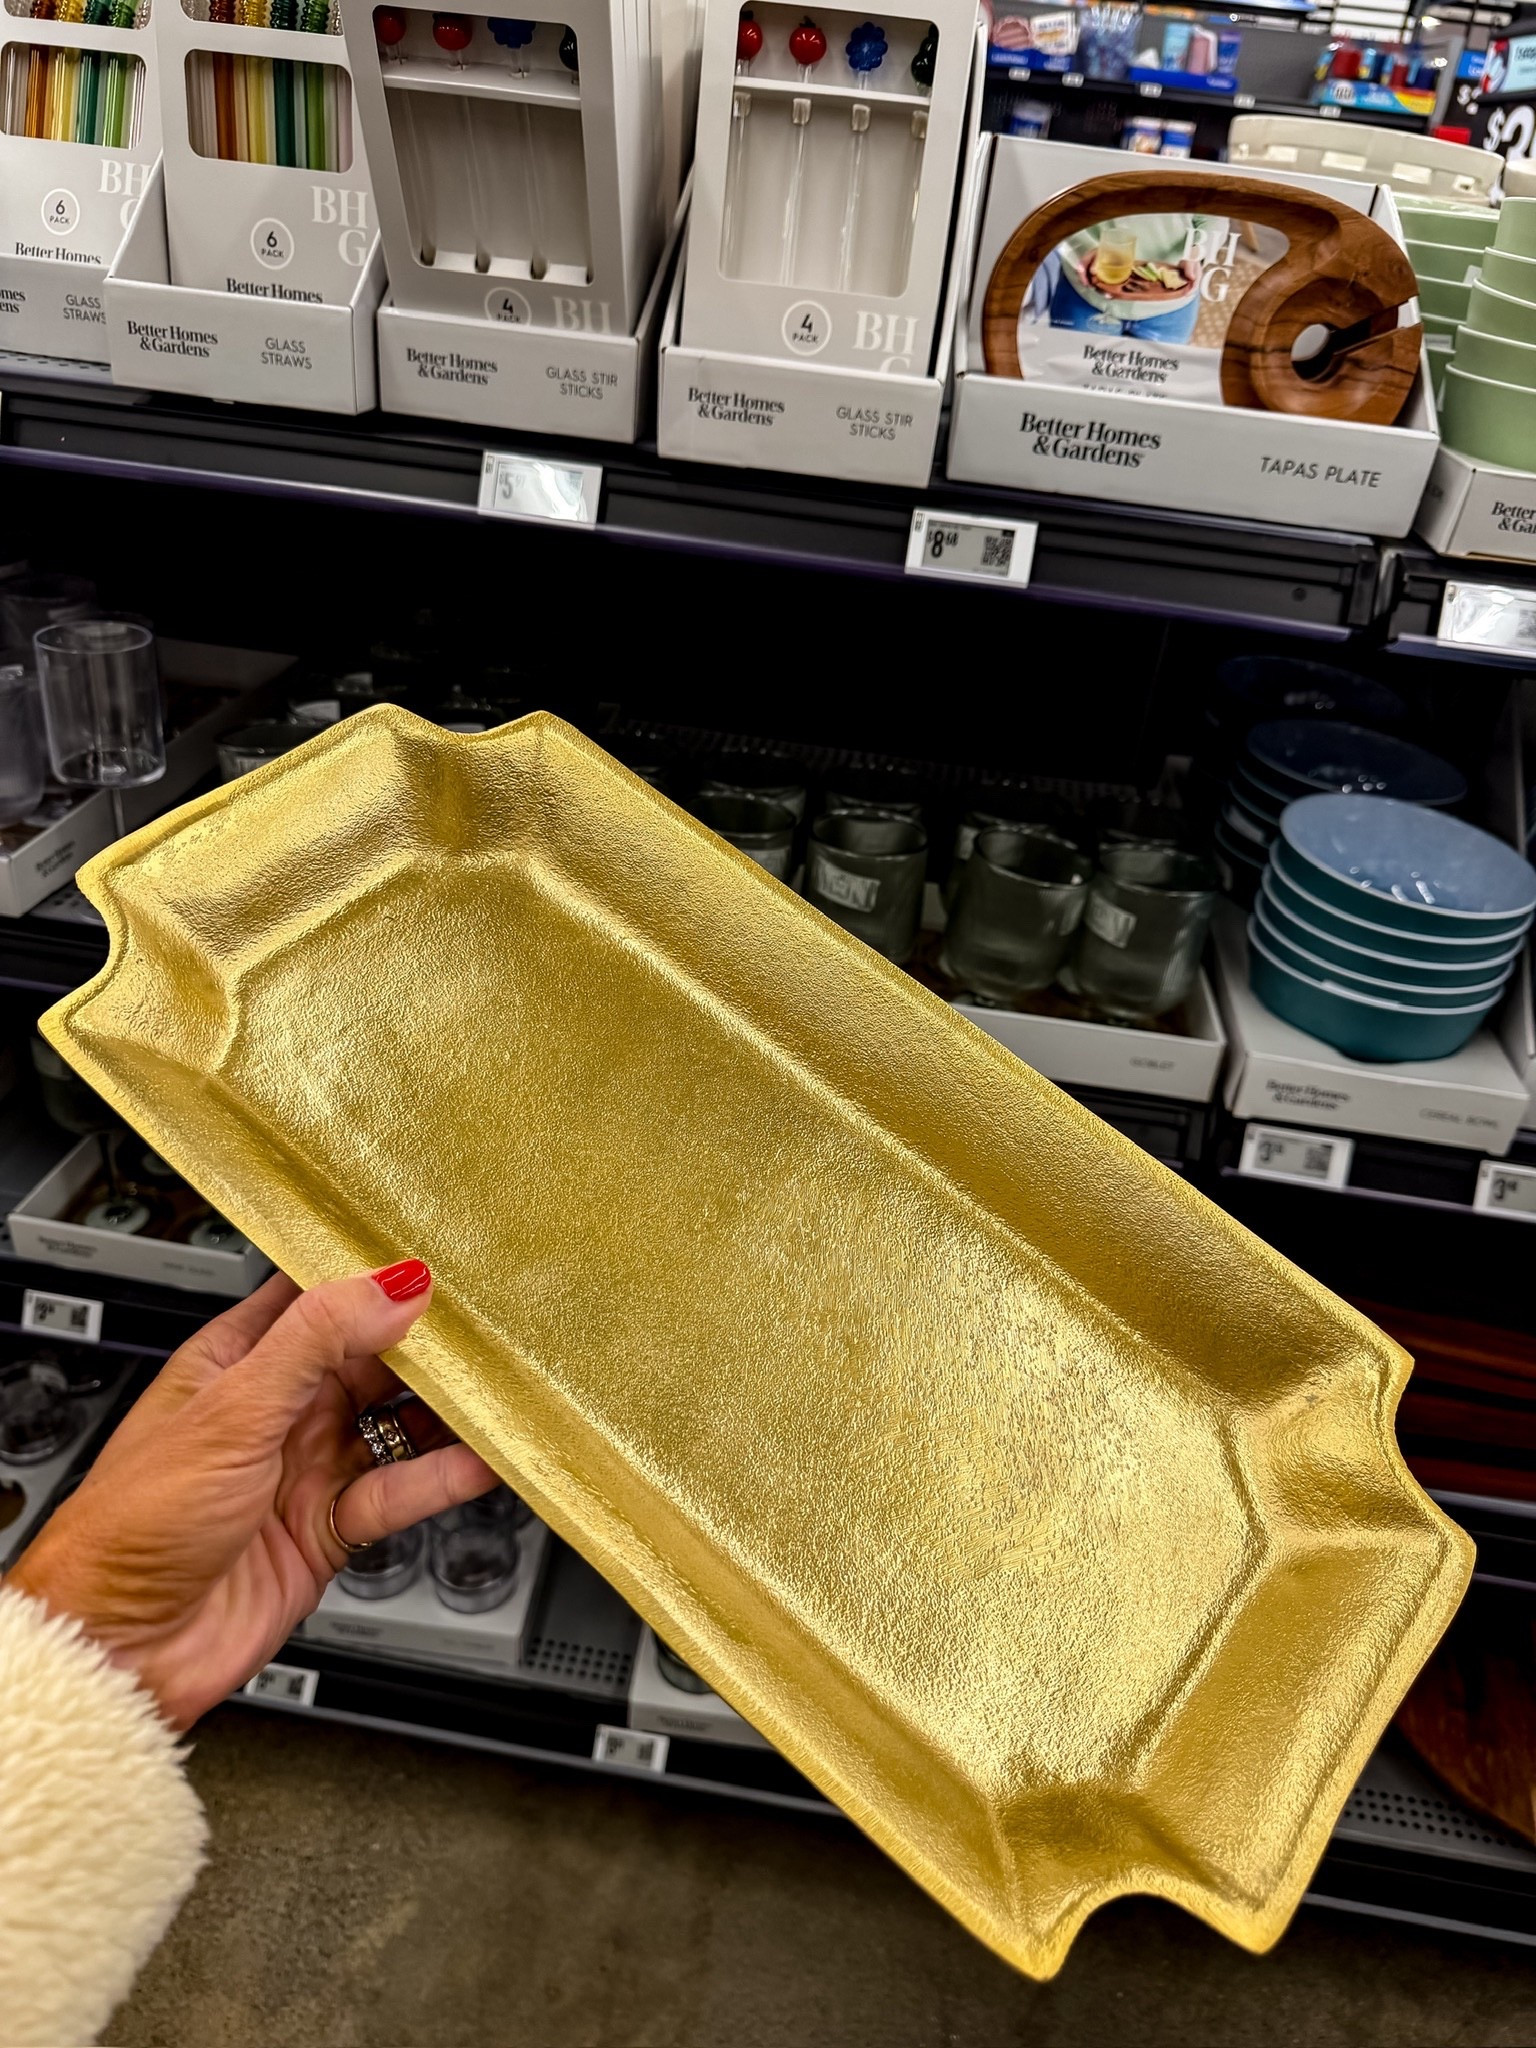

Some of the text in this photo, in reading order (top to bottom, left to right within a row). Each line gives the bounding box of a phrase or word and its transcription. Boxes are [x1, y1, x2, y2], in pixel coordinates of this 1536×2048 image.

[55, 200, 66, 215] 6
[311, 186, 368, 229] BH
[49, 215, 70, 225] PACK
[266, 231, 278, 248] 6
[1182, 227, 1242, 267] BH
[15, 242, 102, 264] Better Homes
[261, 248, 284, 258] PACK
[226, 278, 323, 304] Better Homes
[1200, 265, 1232, 302] G
[65, 294, 101, 309] GLASS
[502, 298, 514, 314] 4
[127, 320, 218, 345] Better Homes
[800, 313, 814, 334] 4
[852, 310, 920, 355] BH
[265, 337, 306, 354] GLASS
[791, 332, 819, 344] PACK
[261, 352, 312, 370] STRAWS
[406, 348, 498, 373] Better Homes
[1083, 345, 1180, 371] Better Homes
[546, 366, 618, 387] GLASS STIR
[560, 383, 604, 400] STICKS
[688, 387, 785, 414] Better Homes
[836, 405, 914, 428] GLASS STIR
[849, 424, 896, 441] STICKS
[1019, 412, 1161, 451] Better Homes
[1260, 456, 1382, 488] TAPAS PLATE
